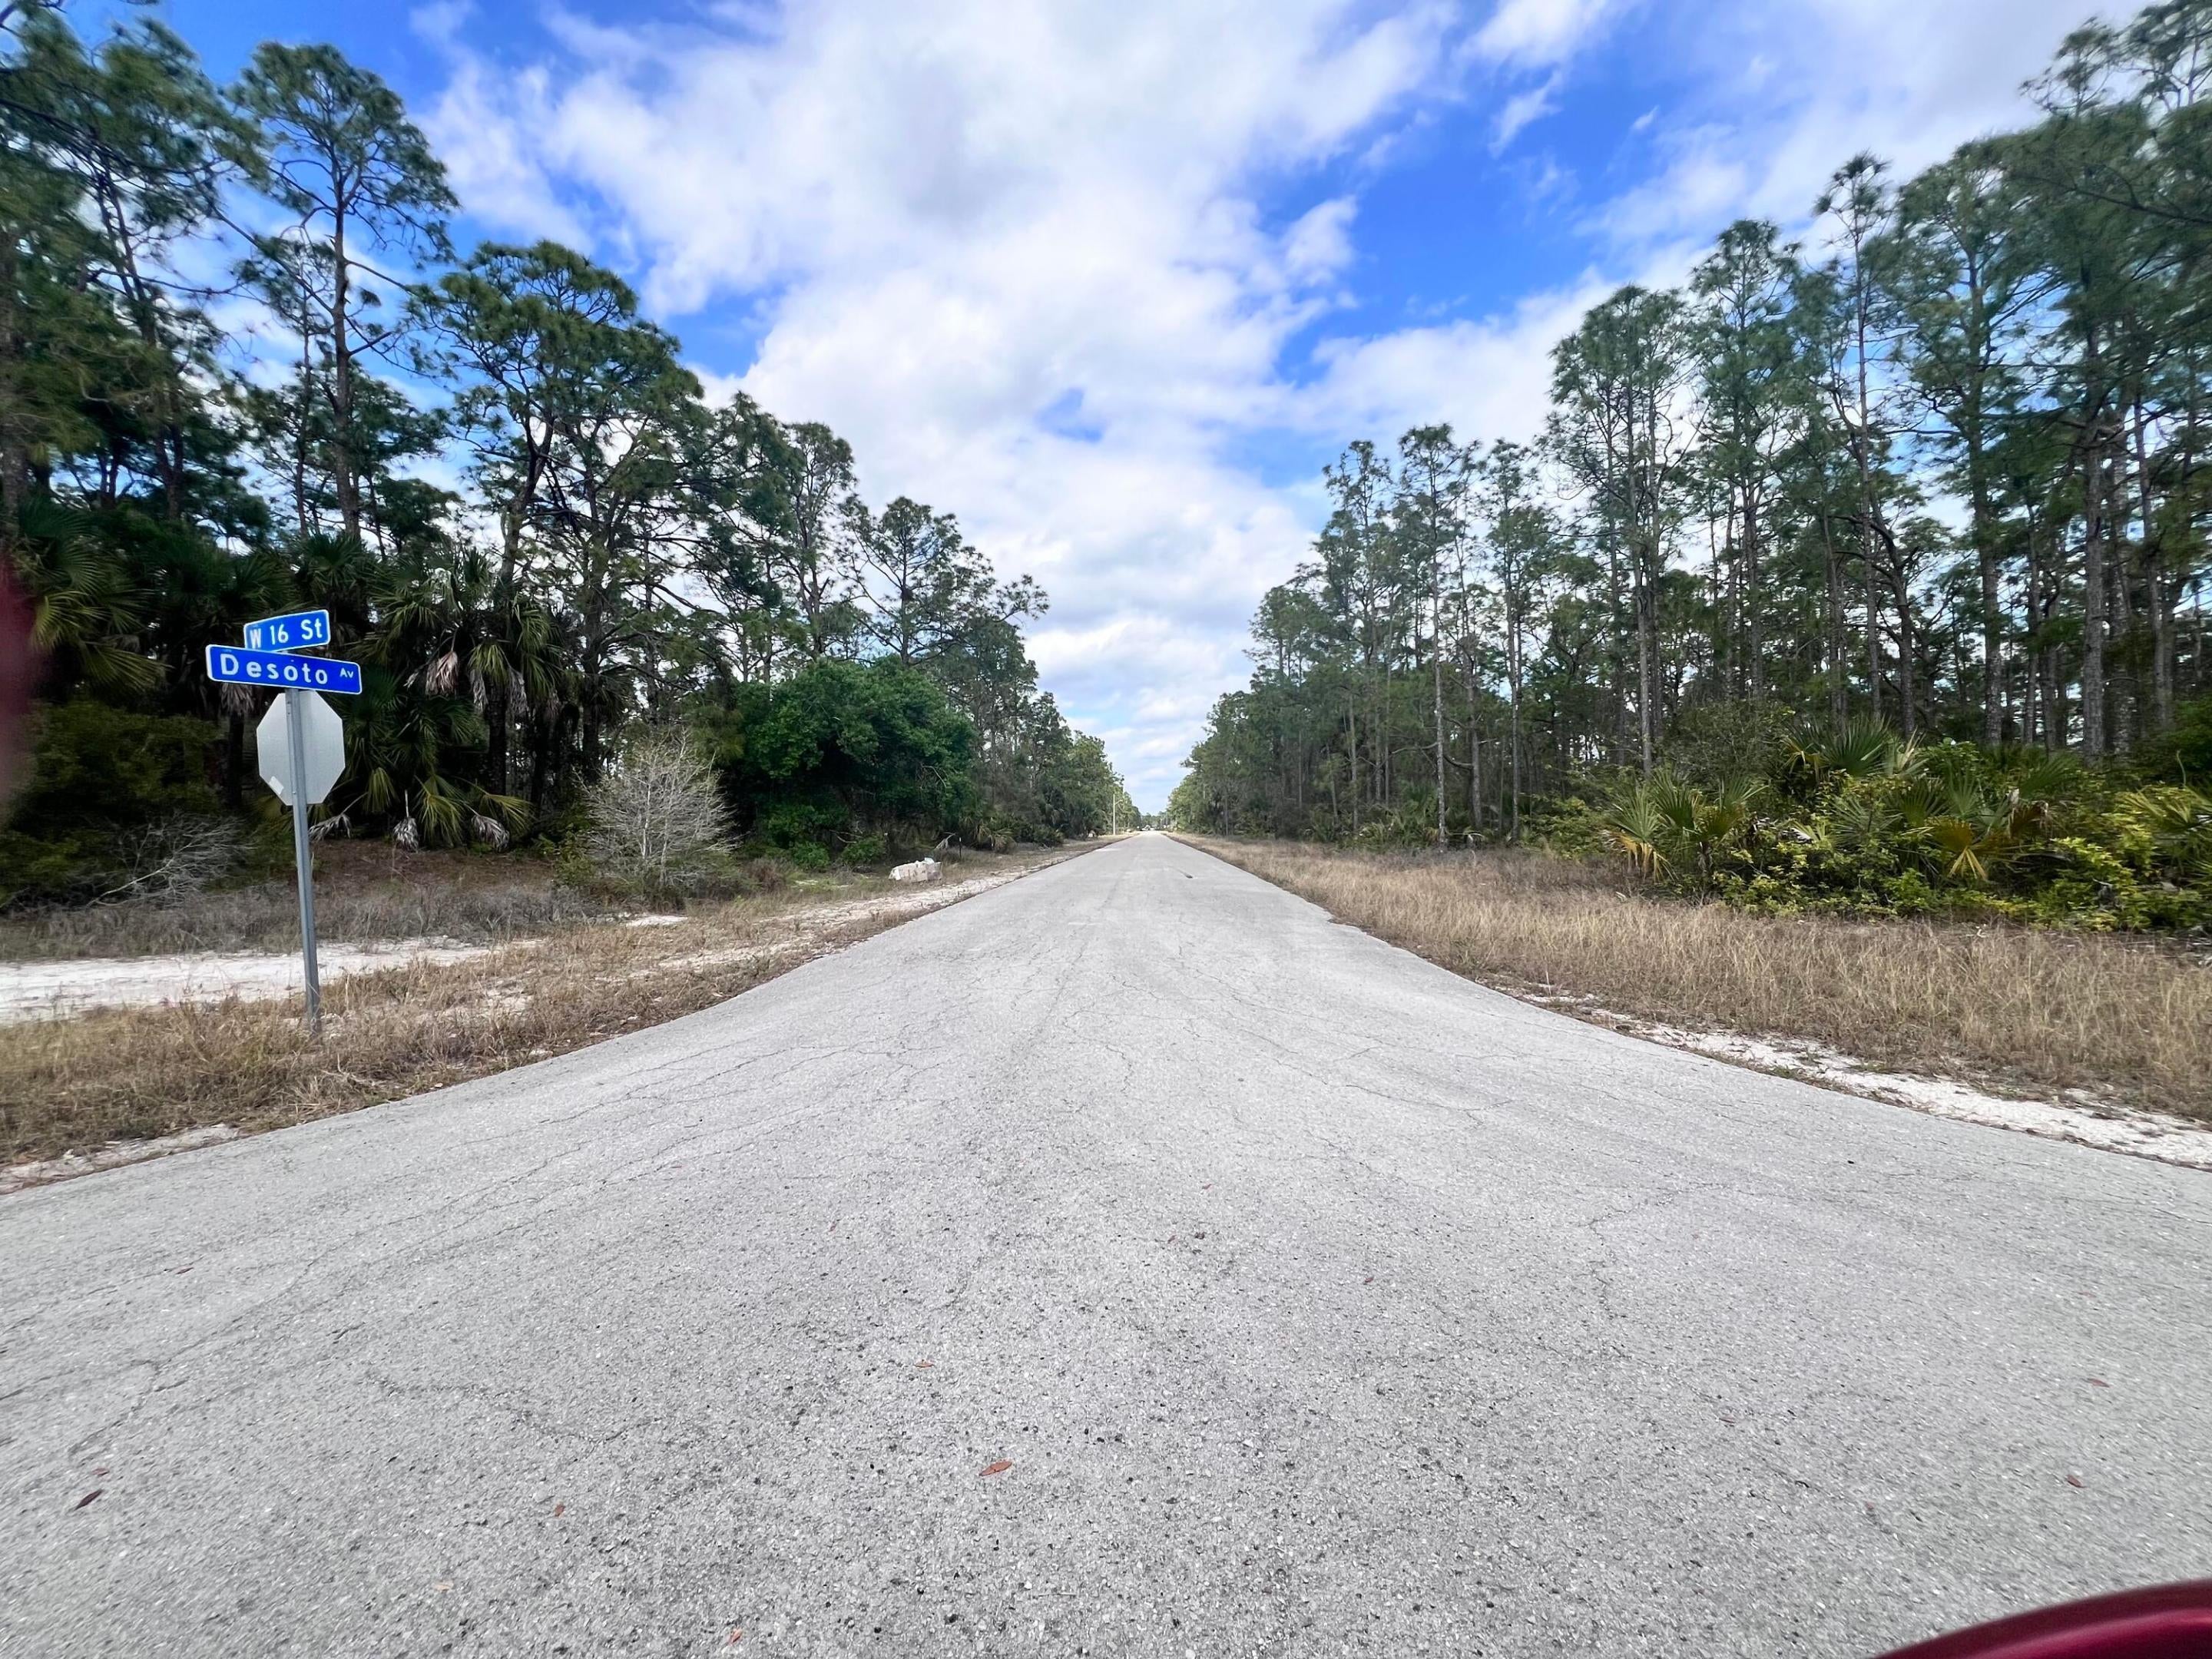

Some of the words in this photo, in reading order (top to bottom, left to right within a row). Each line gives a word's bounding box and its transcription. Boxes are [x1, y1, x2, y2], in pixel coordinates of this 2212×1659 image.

[250, 628, 262, 649] W
[270, 624, 289, 645] 16
[300, 618, 323, 640] St
[220, 653, 328, 685] Desoto
[339, 667, 354, 678] Av
